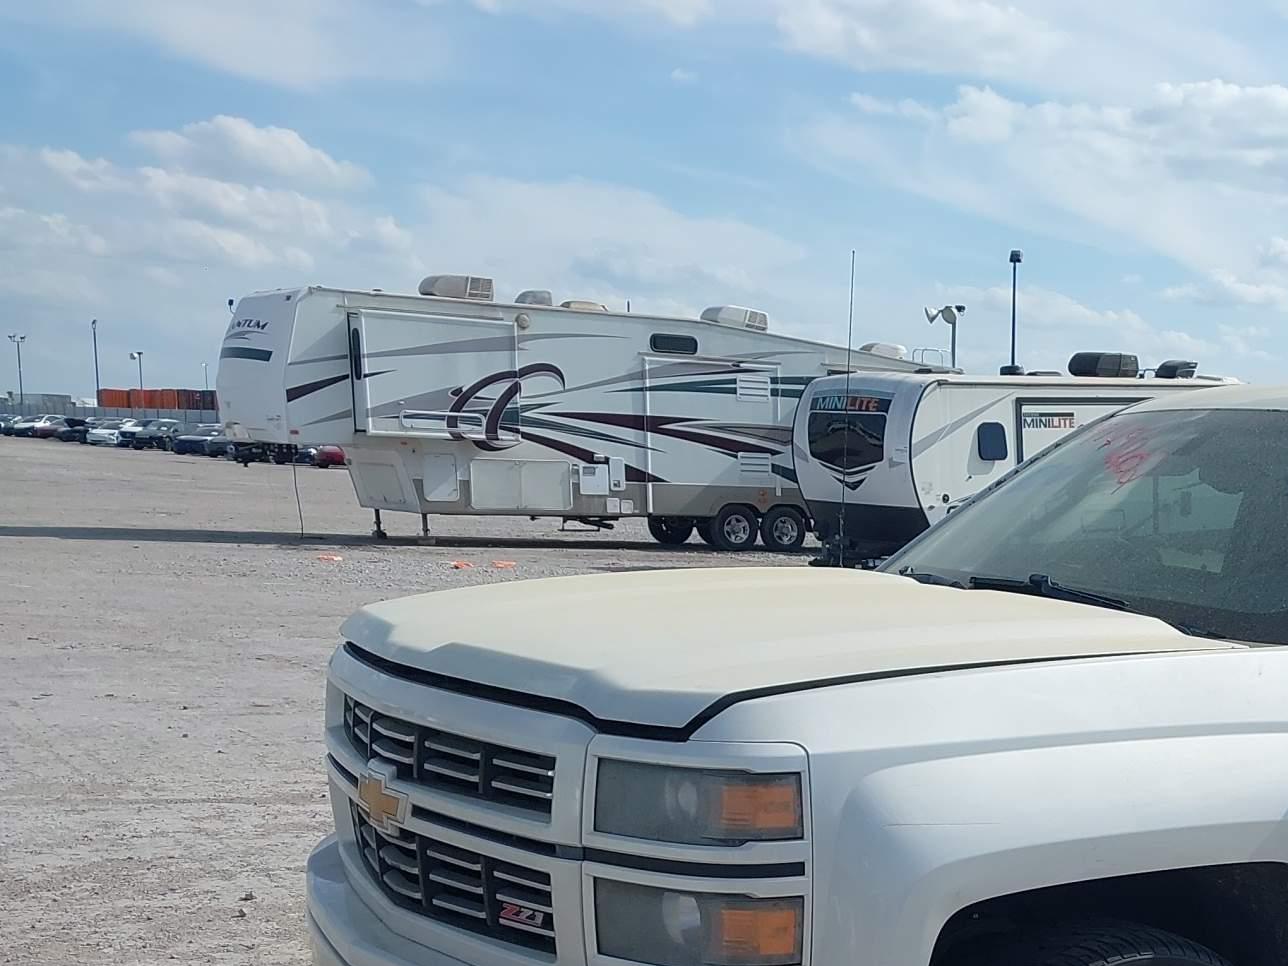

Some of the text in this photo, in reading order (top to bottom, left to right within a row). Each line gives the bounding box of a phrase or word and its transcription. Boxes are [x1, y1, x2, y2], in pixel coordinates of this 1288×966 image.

[816, 396, 880, 411] MINILITE
[1023, 417, 1075, 429] MINILITE
[500, 903, 544, 927] Z71
